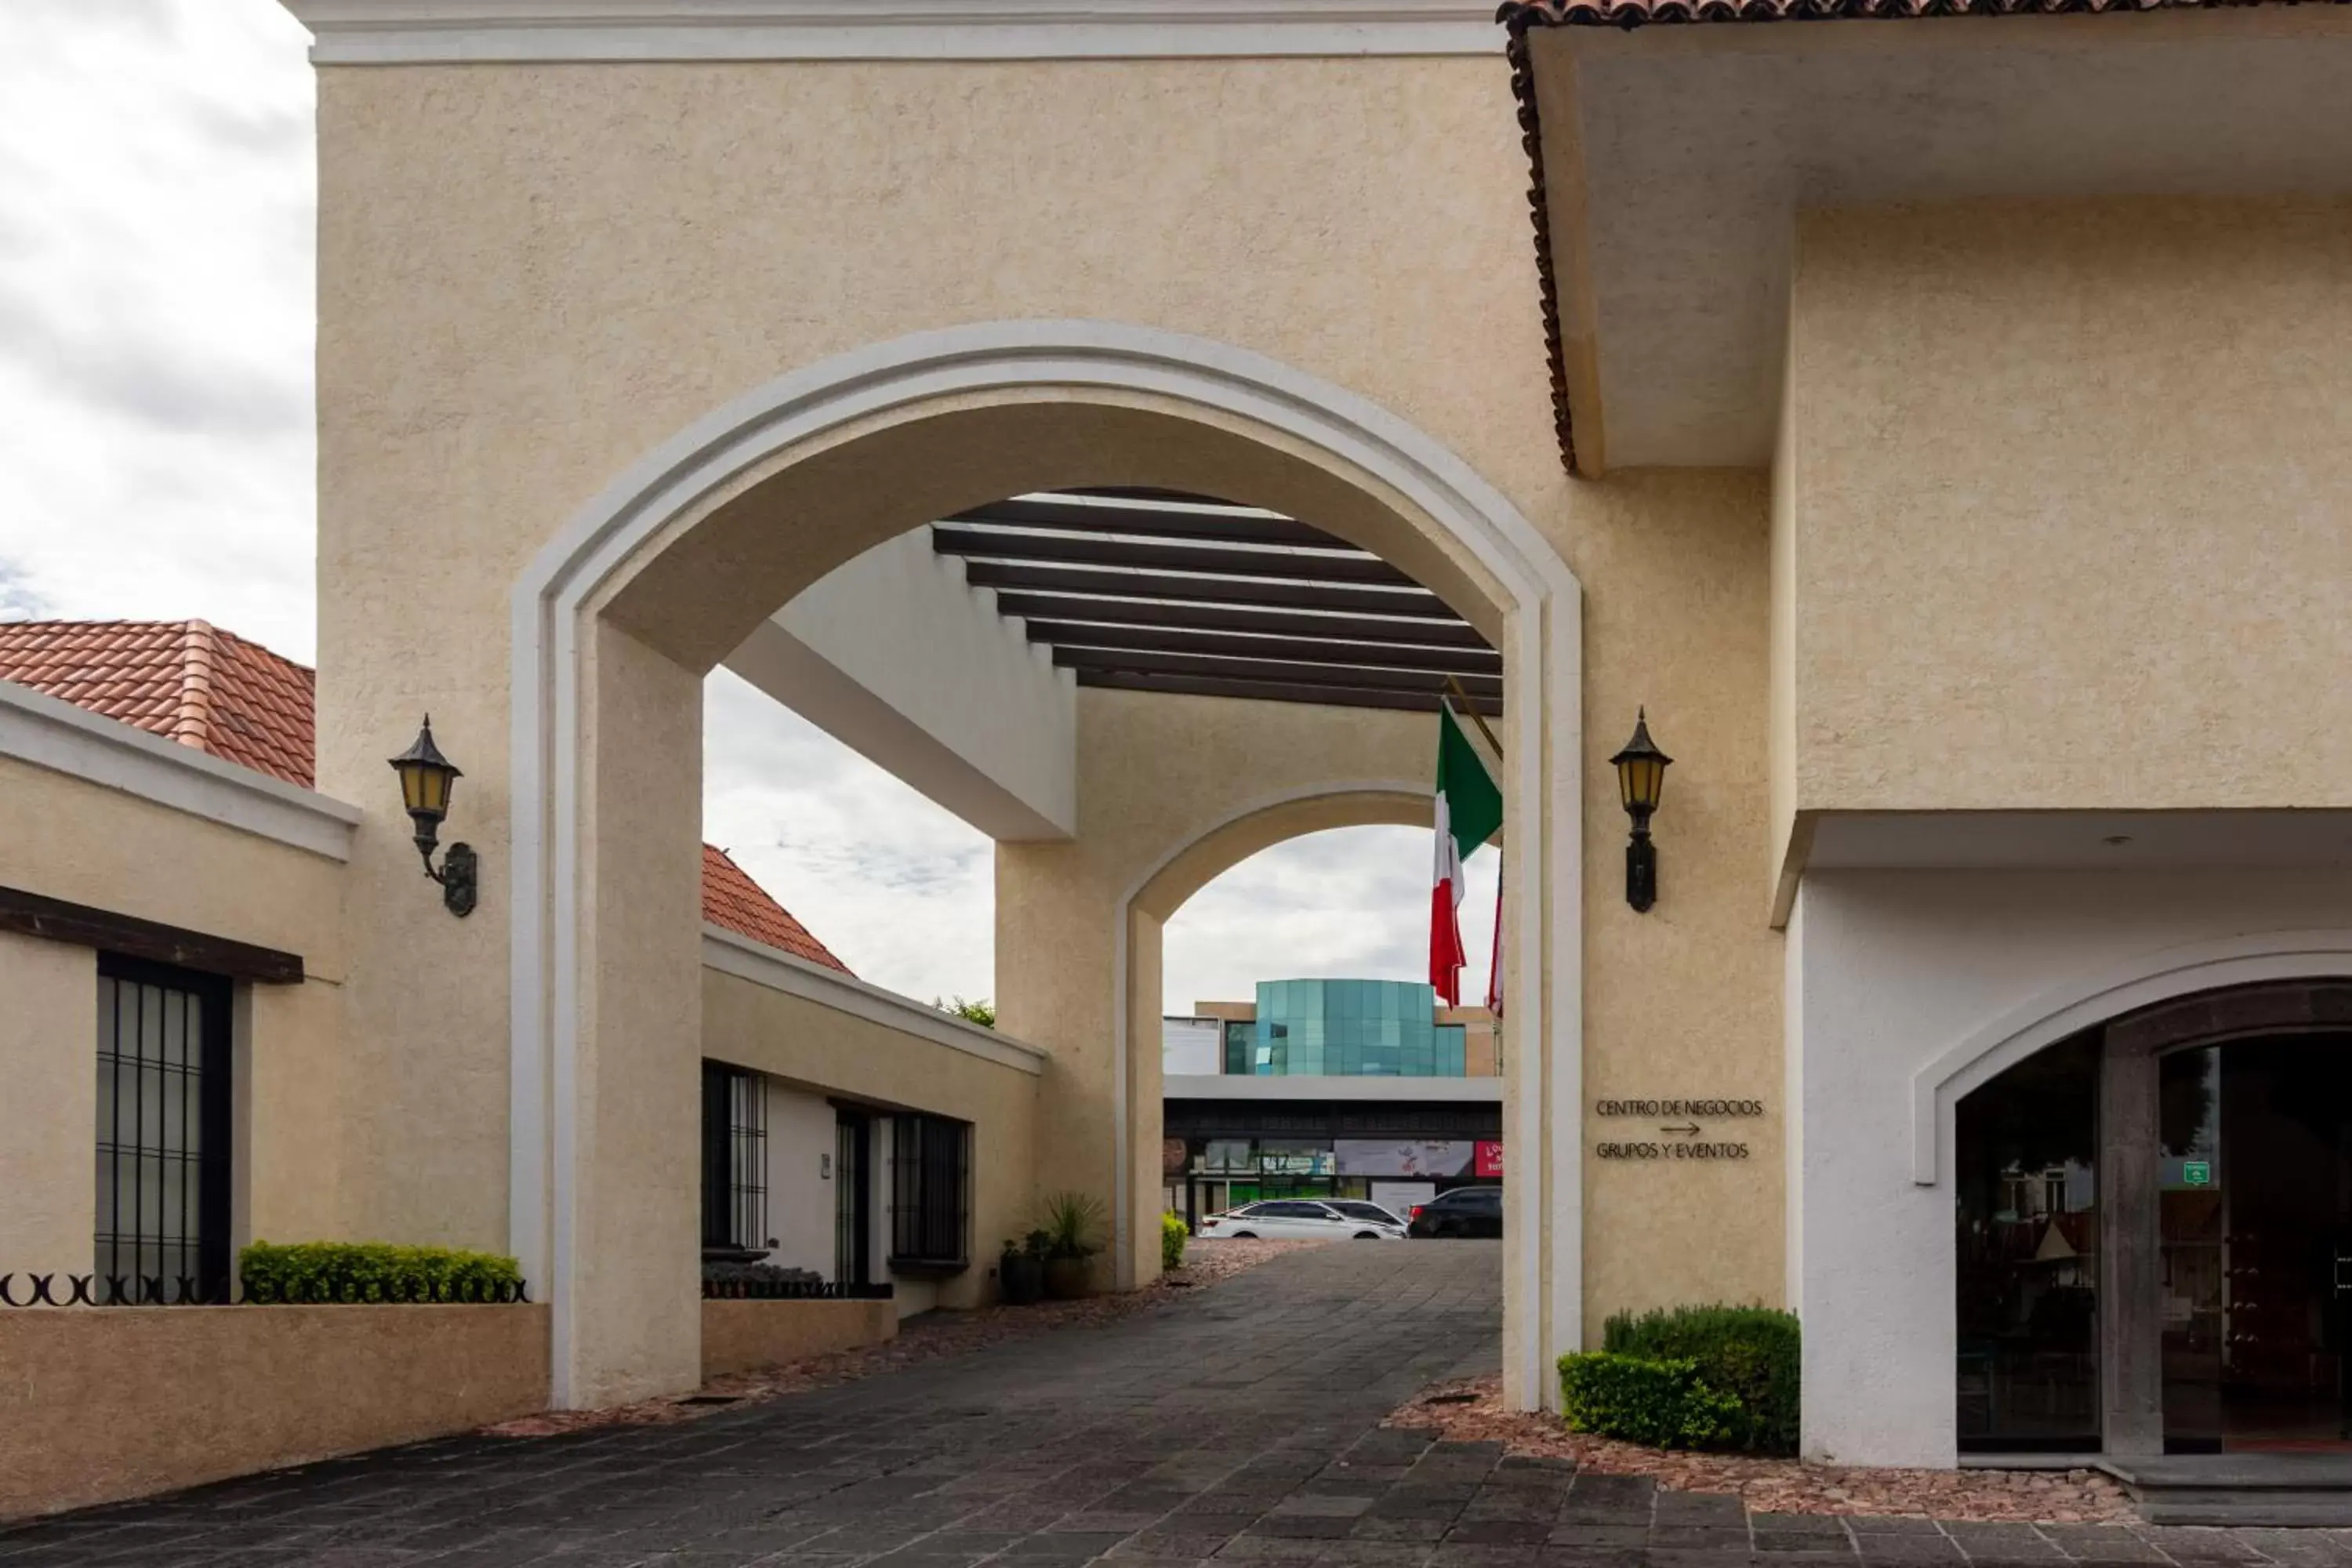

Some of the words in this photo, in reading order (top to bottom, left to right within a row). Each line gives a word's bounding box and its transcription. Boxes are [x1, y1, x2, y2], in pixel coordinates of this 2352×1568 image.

[1596, 1100, 1658, 1116] CENTRO
[1661, 1100, 1682, 1116] DE
[1685, 1100, 1763, 1116] NEGOCIOS
[1596, 1142, 1659, 1159] GRUPOS
[1661, 1143, 1672, 1158] Y
[1676, 1142, 1750, 1159] EVENTOS
